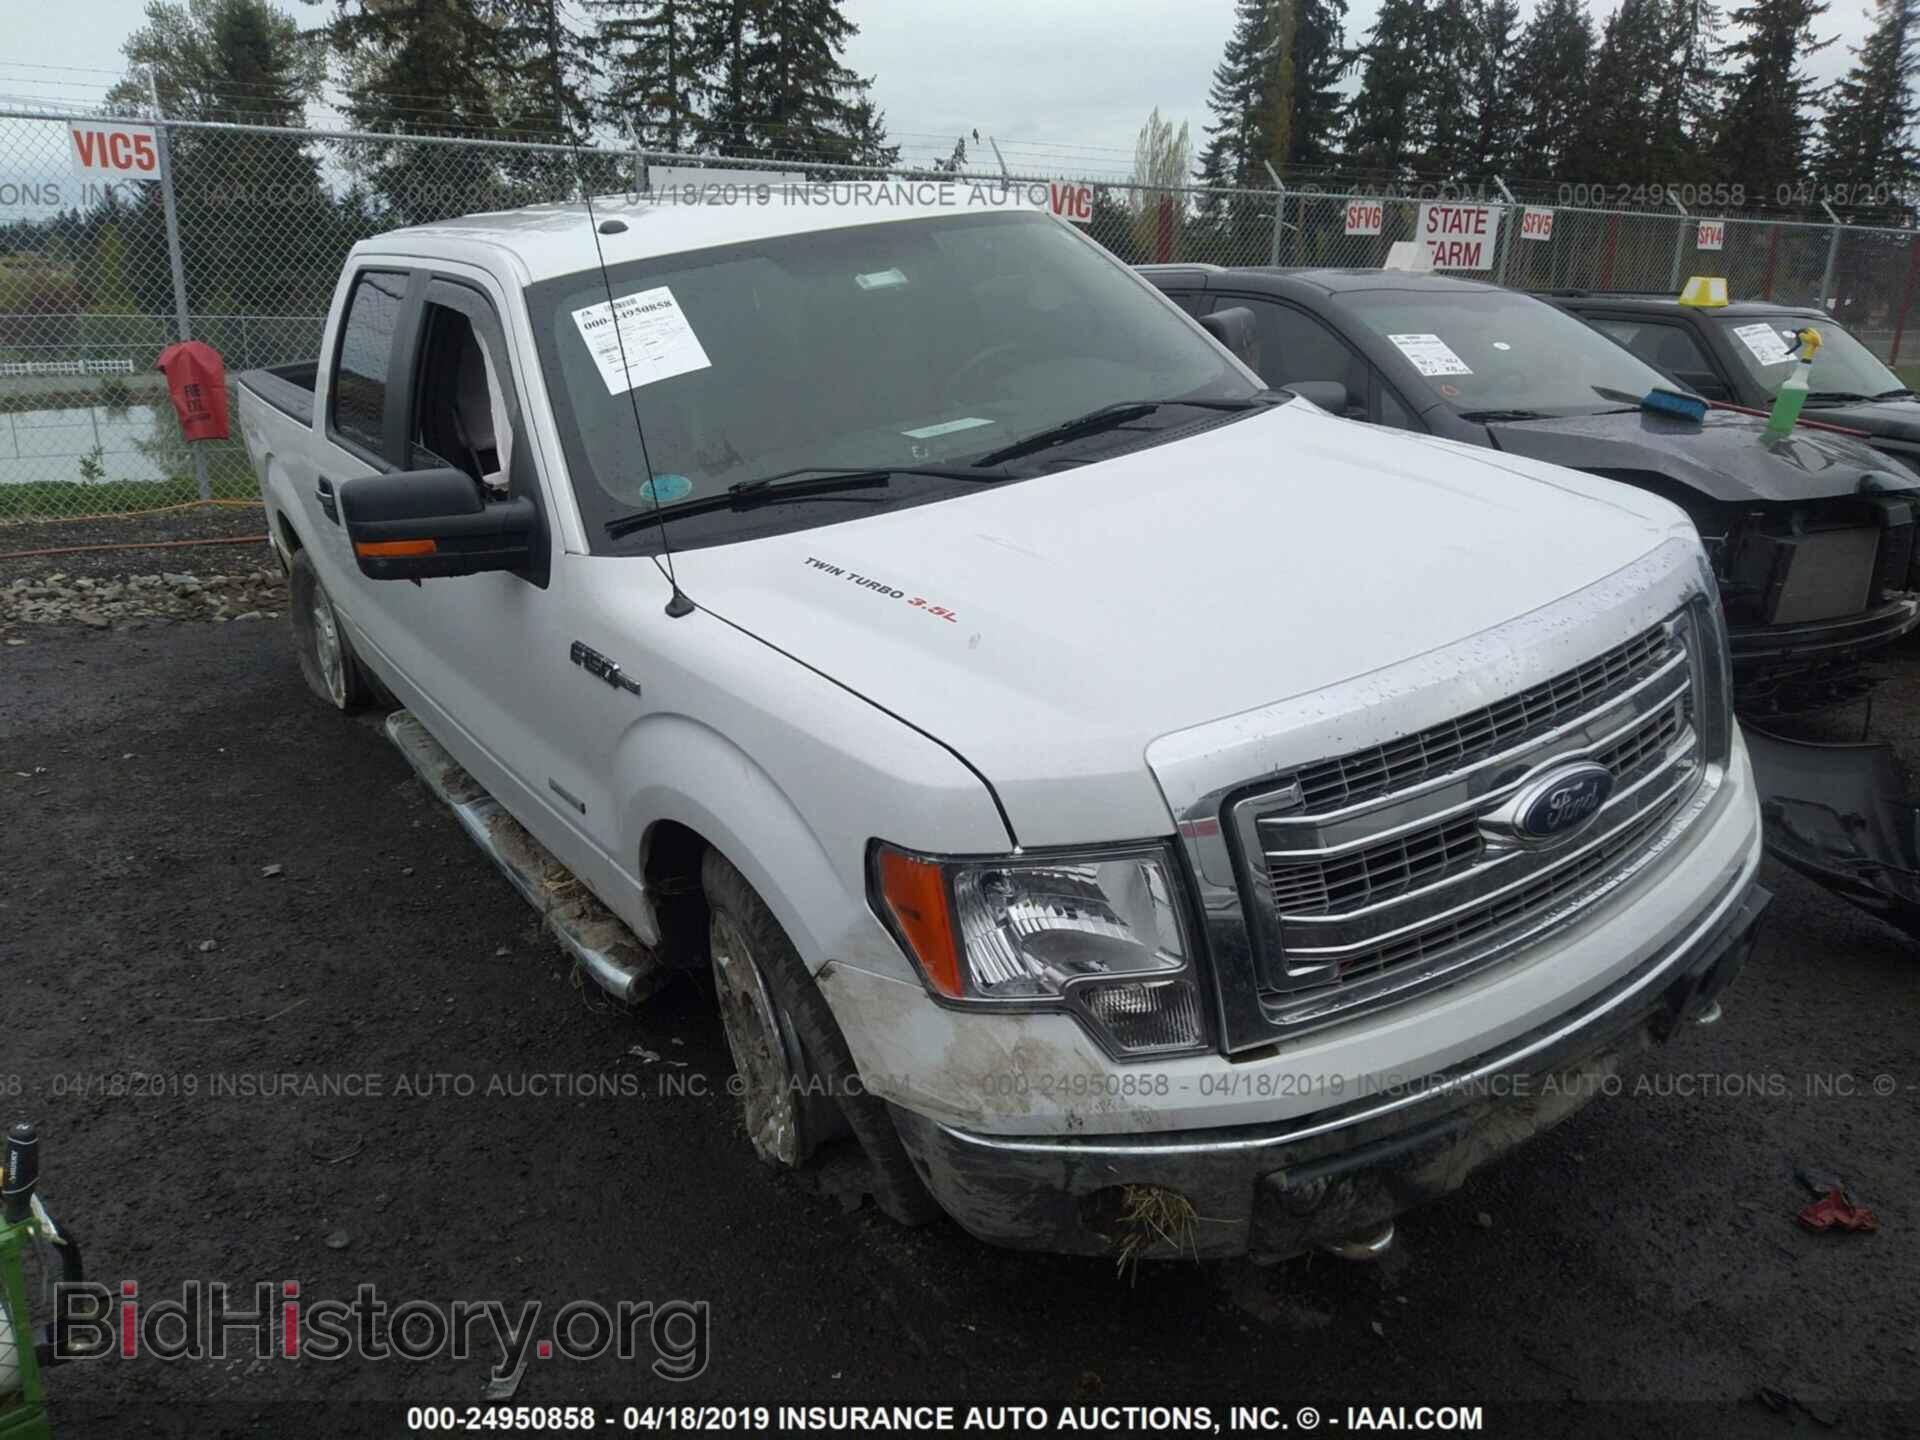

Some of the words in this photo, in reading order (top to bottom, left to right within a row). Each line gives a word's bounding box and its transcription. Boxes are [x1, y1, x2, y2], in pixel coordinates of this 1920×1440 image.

[73, 129, 157, 171] VIC5
[1051, 183, 1092, 219] VIC
[1347, 206, 1381, 230] SFV6
[1426, 206, 1488, 235] STATE
[1521, 212, 1552, 236] SFV5
[804, 556, 845, 577] TWIN
[846, 572, 905, 599] TURBO
[907, 596, 957, 623] 3.5L
[1548, 781, 1600, 826] Ford
